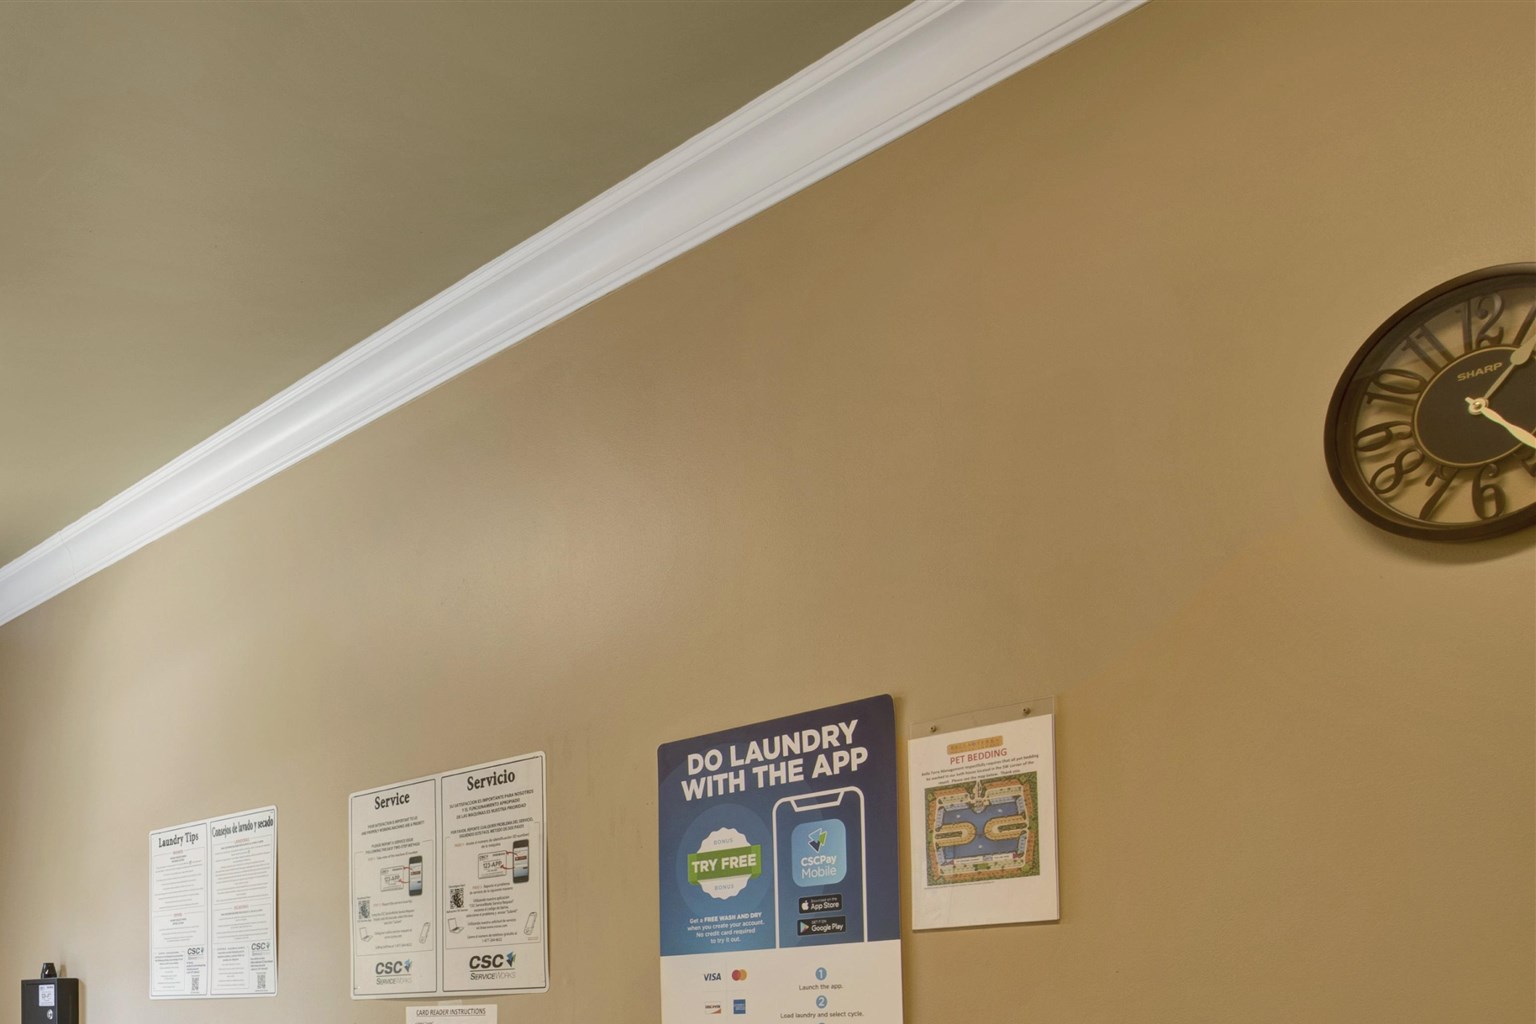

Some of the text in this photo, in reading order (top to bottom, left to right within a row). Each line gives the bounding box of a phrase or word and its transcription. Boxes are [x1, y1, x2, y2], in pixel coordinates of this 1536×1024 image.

[1456, 293, 1505, 350] 12
[1402, 324, 1456, 373] 11
[1457, 362, 1504, 382] SHARP
[1366, 368, 1428, 406] 10
[1354, 420, 1412, 452] 9
[1370, 447, 1425, 495] 8
[1419, 464, 1459, 521] 7
[1472, 463, 1506, 520] 6
[687, 719, 859, 776] DO LAUNDRY
[950, 748, 1007, 765] PET BEDDING
[466, 769, 515, 791] Servicio
[681, 747, 868, 802] WITH THE APP
[374, 792, 410, 810] Service
[212, 826, 231, 838] Consejos
[232, 822, 237, 833] de
[238, 820, 254, 832] lavado
[258, 816, 274, 828] secado
[158, 832, 199, 848] Laundry Tips
[692, 853, 757, 873] TRY FREE
[800, 855, 837, 867] CSCPay
[801, 865, 837, 879] Mobile
[823, 901, 840, 909] Store
[811, 923, 843, 932] Google Play
[187, 947, 200, 955] CSC
[251, 942, 266, 950] CSC
[375, 961, 402, 975] CSC
[469, 954, 504, 969] CSC
[704, 972, 721, 981] VISA
[818, 997, 825, 1006] 2
